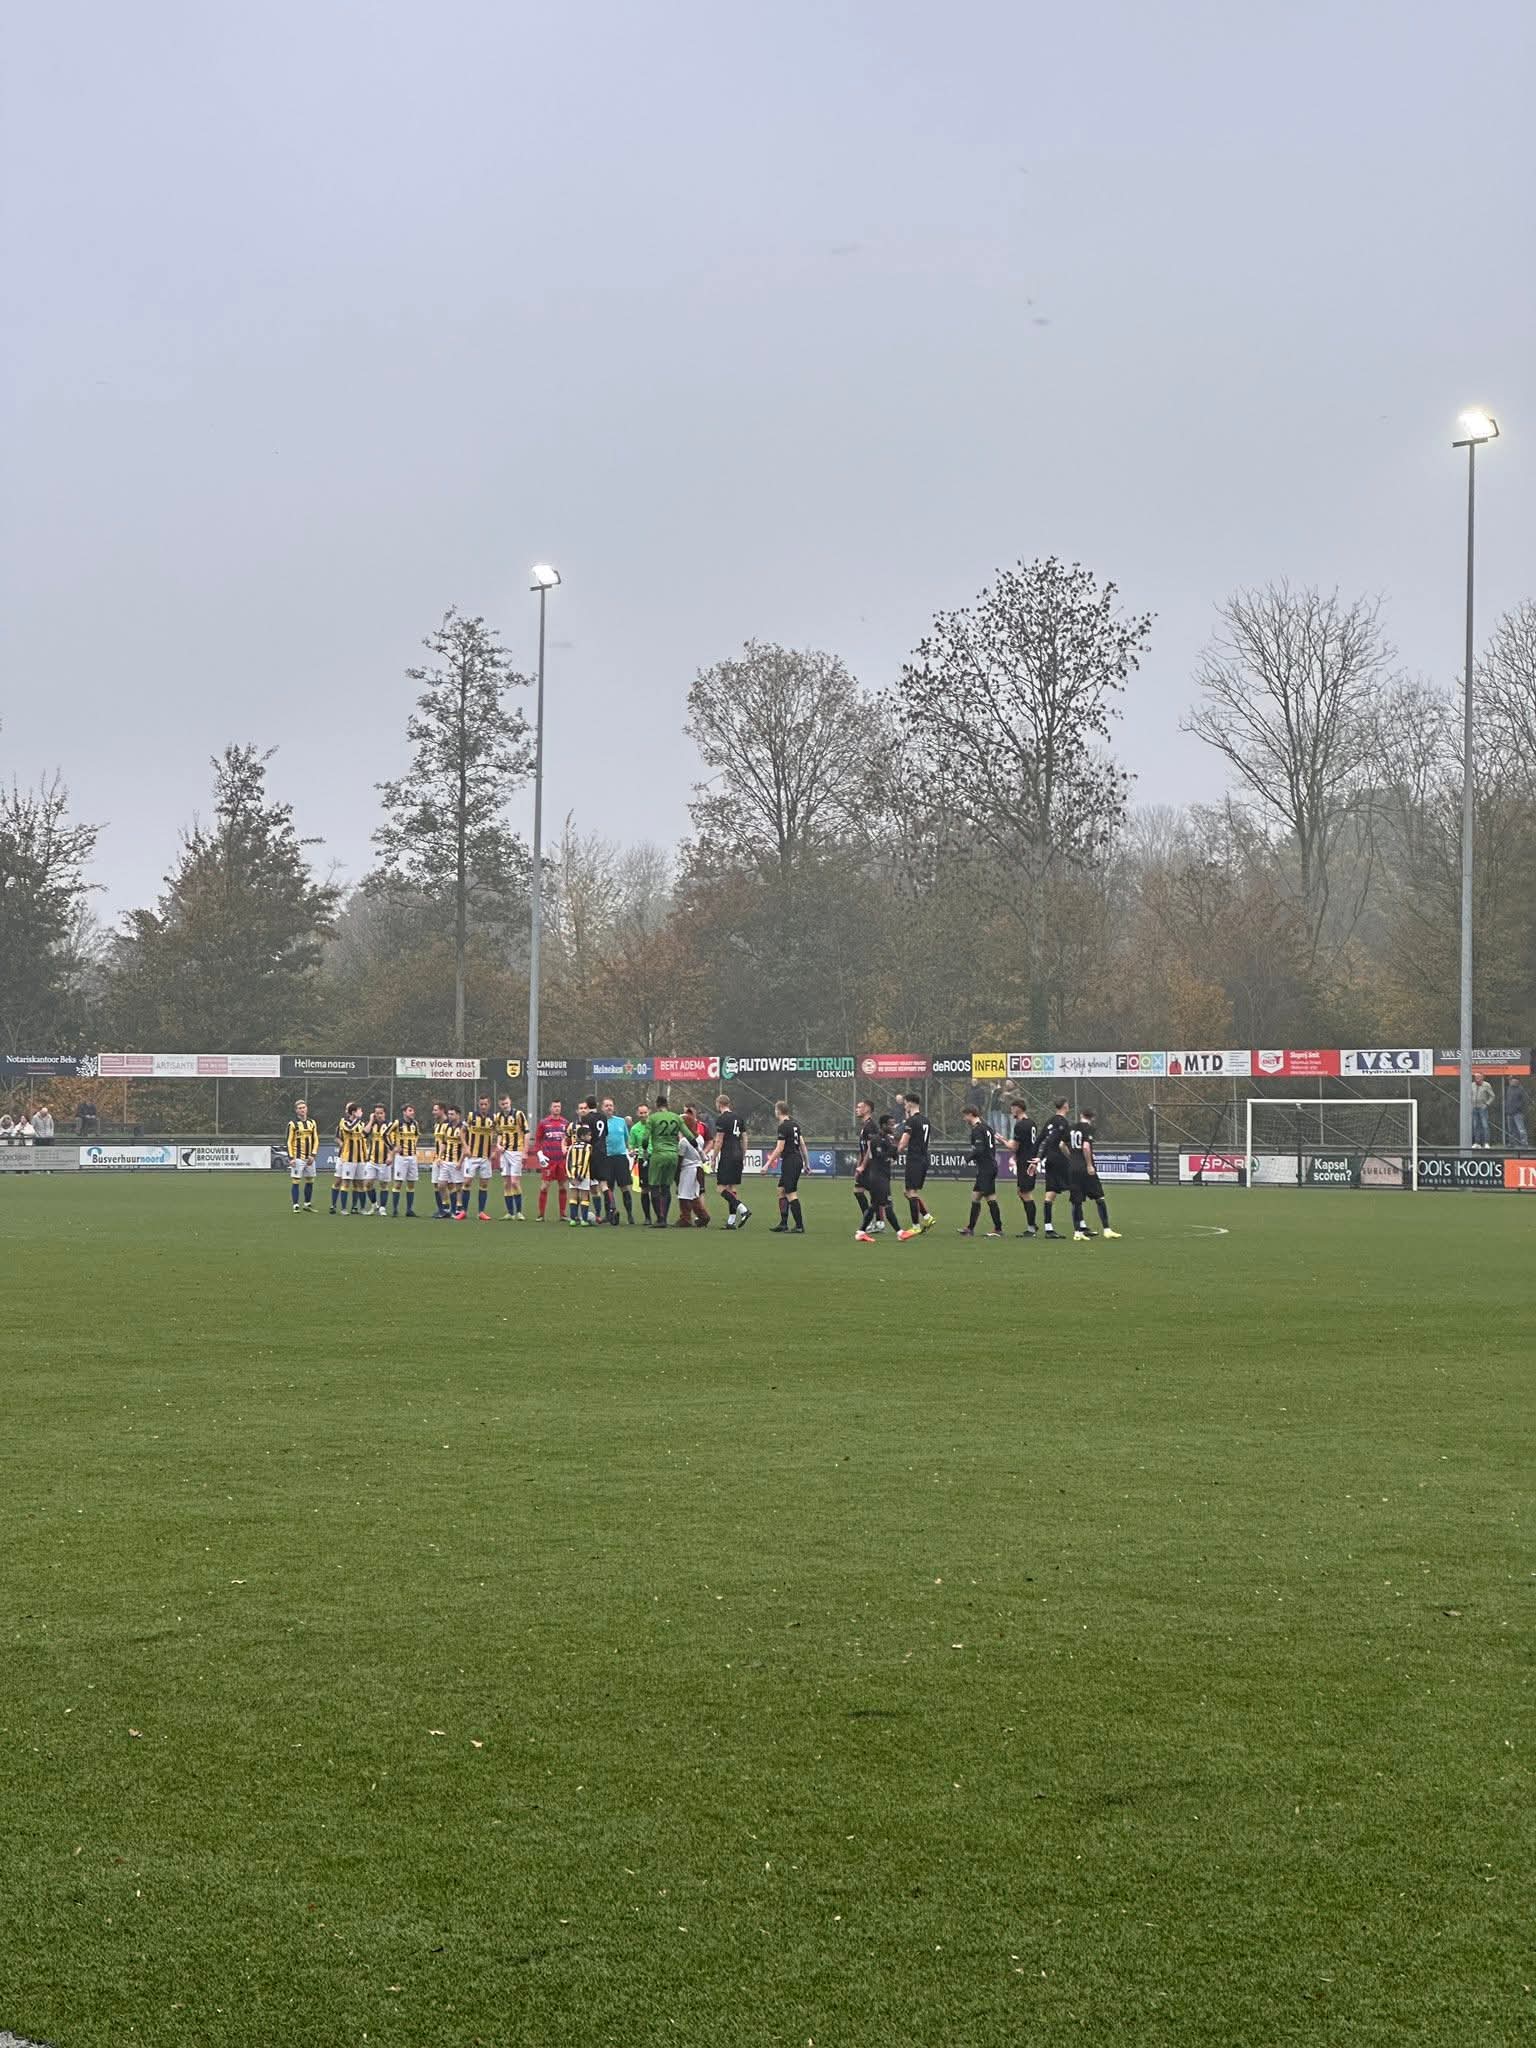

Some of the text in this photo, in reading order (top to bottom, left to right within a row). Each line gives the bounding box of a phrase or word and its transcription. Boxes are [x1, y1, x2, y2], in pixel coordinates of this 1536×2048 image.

[6, 1055, 76, 1064] Notariskantoor Beks
[1361, 1052, 1413, 1069] V&G
[1441, 1050, 1456, 1058] VAN
[294, 1058, 326, 1068] Hellema
[410, 1059, 475, 1068] Een vloek mist
[593, 1064, 623, 1074] Heineken
[660, 1060, 705, 1070] BERT ADEMA
[974, 1058, 1005, 1071] INFRA
[1184, 1055, 1223, 1071] MTD
[431, 1069, 475, 1078] ieder doel
[596, 1120, 605, 1137] 9
[659, 1120, 680, 1137] 22
[732, 1119, 741, 1137] 4
[922, 1124, 929, 1142] 7
[1031, 1126, 1036, 1144] 8
[793, 1126, 799, 1145] 5
[1070, 1130, 1082, 1149] 10
[1200, 1156, 1246, 1170] SPAR
[1314, 1158, 1348, 1172] Kapsel
[1313, 1169, 1352, 1181] scoren?
